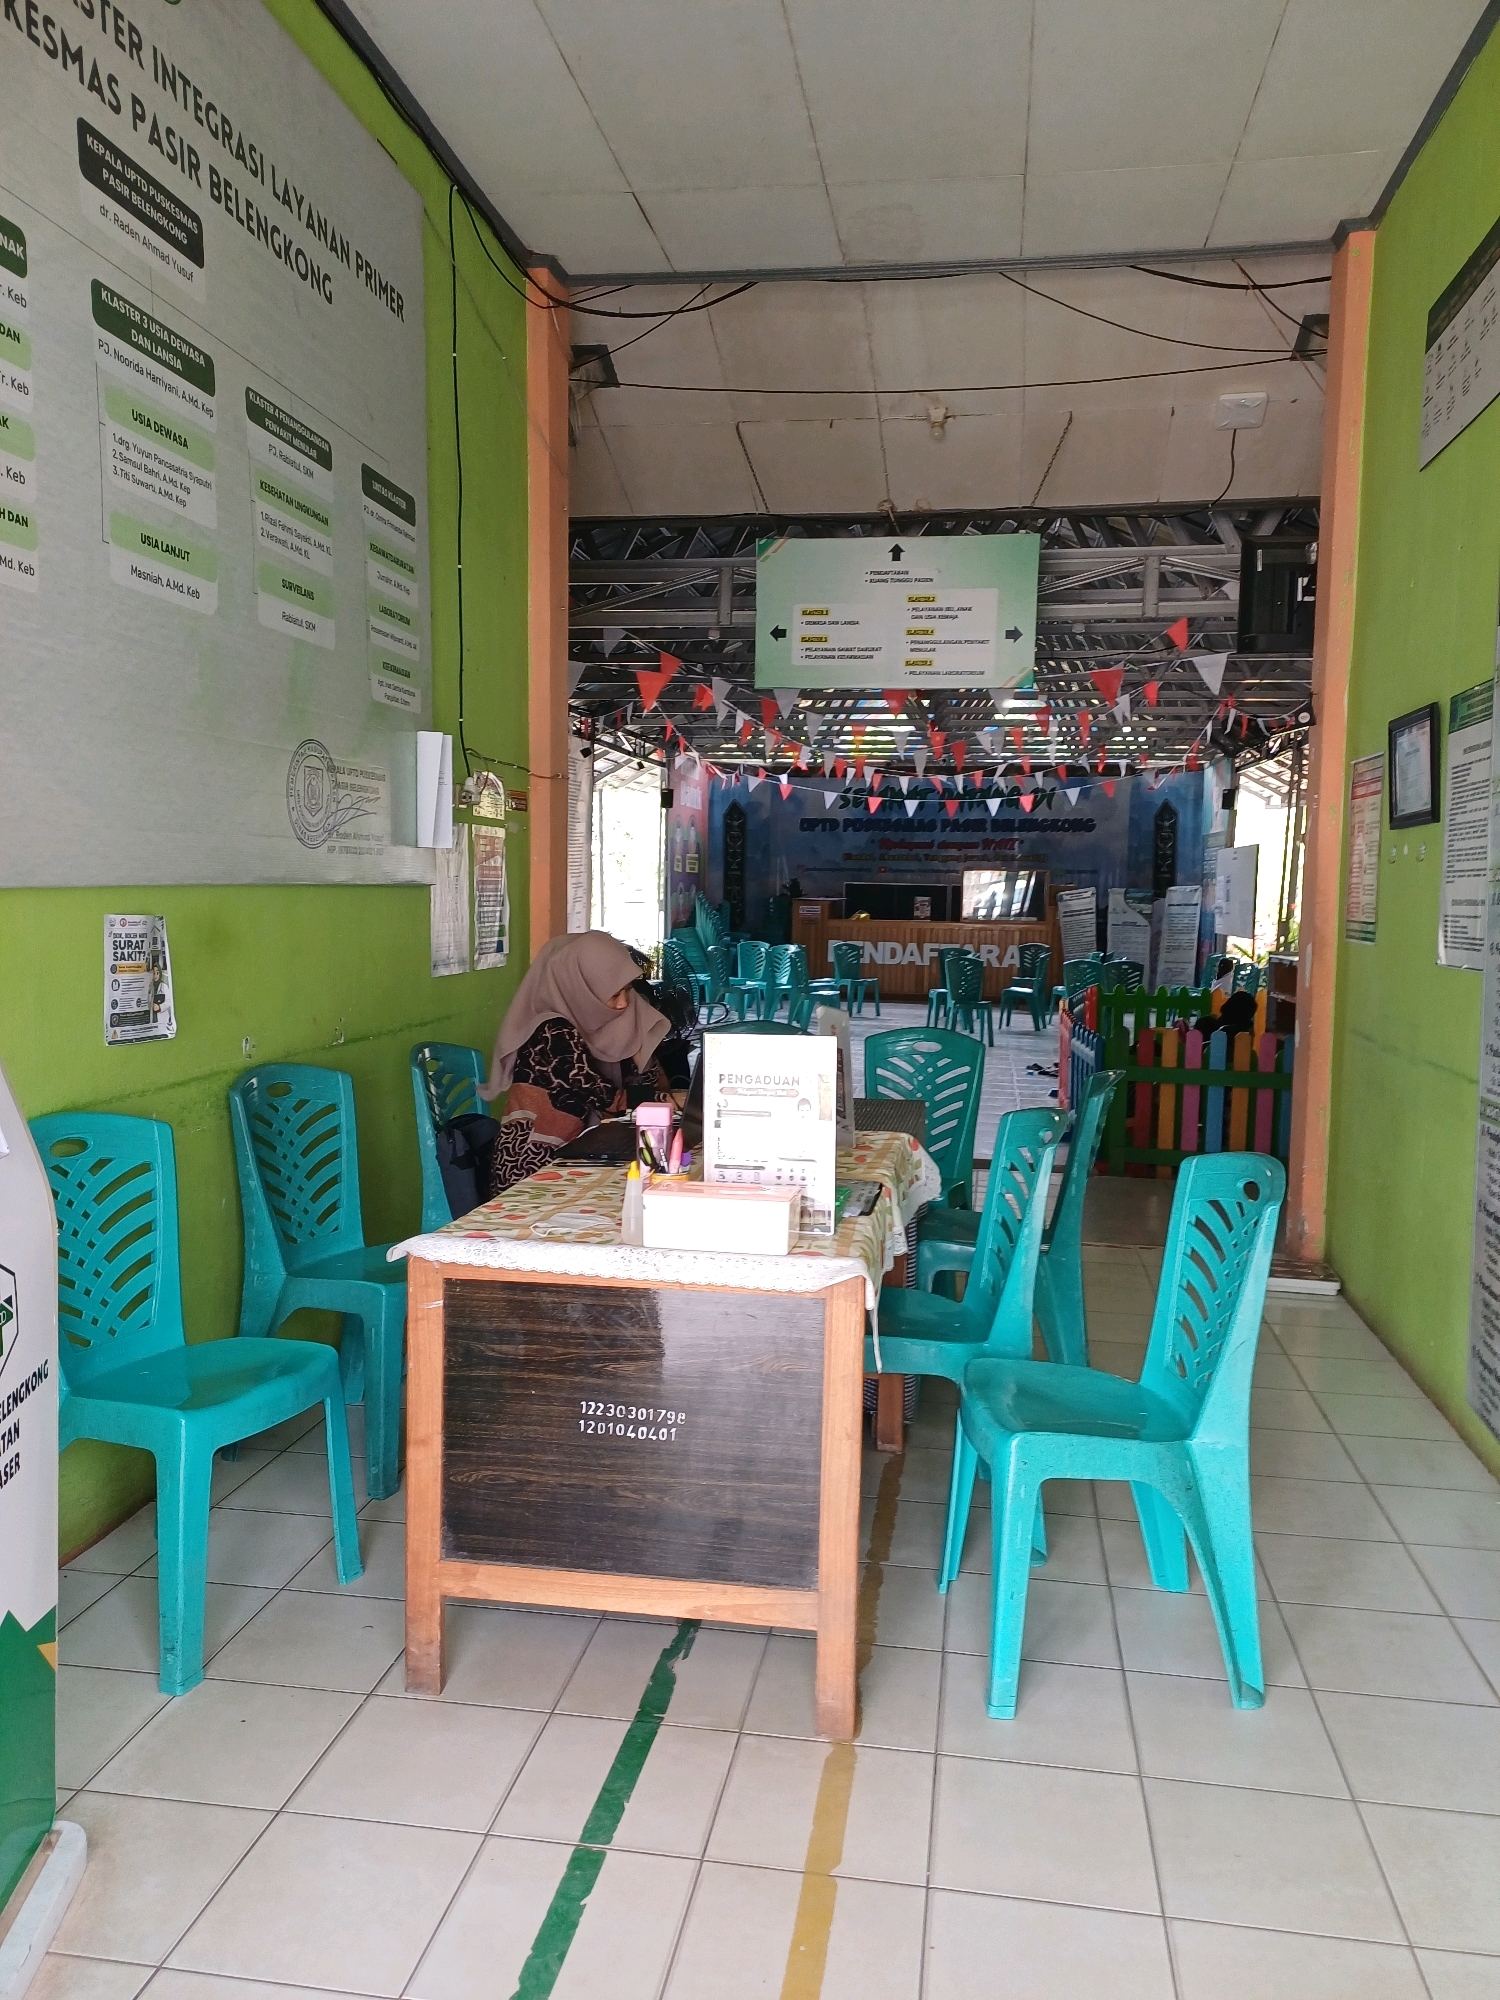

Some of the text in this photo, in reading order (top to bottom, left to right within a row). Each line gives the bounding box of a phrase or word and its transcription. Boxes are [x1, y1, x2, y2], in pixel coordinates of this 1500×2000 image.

[86, 133, 198, 235] KEPALA UPTD PUSKESMAS
[153, 44, 265, 186] INTEGRASI
[271, 164, 351, 269] LAYANAN
[355, 250, 404, 322] PRIMER
[102, 167, 188, 245] PASIR BELENGKONG
[131, 92, 201, 189] PASIR
[209, 163, 332, 305] BELENGKONG
[99, 204, 194, 283] dr. Raden Ahmad Yusuf
[7, 286, 27, 308] Keb
[101, 287, 206, 368] KLASTER 3 USIA DEWASA
[131, 328, 183, 372] DAN LANSIA
[11, 376, 29, 395] Keb
[113, 347, 144, 375] Noorida
[201, 401, 214, 419] Kep
[248, 390, 274, 416] KLASTER
[132, 408, 189, 450] USIA DEWASA
[265, 417, 292, 443] PENYAKIT
[132, 442, 153, 461] Yuyun
[6, 466, 26, 485] Keb
[259, 479, 294, 507] KESEHATAN
[8, 510, 28, 528] DAN
[140, 532, 190, 562] USIA LANJUT
[18, 560, 35, 576] Keb
[186, 585, 200, 600] Keb
[112, 939, 145, 950] SURAT
[112, 950, 146, 962] SAKIT?
[718, 1073, 800, 1086] PENGADUAN
[580, 1401, 687, 1425] 12230301798
[578, 1420, 678, 1441] 1201040401
